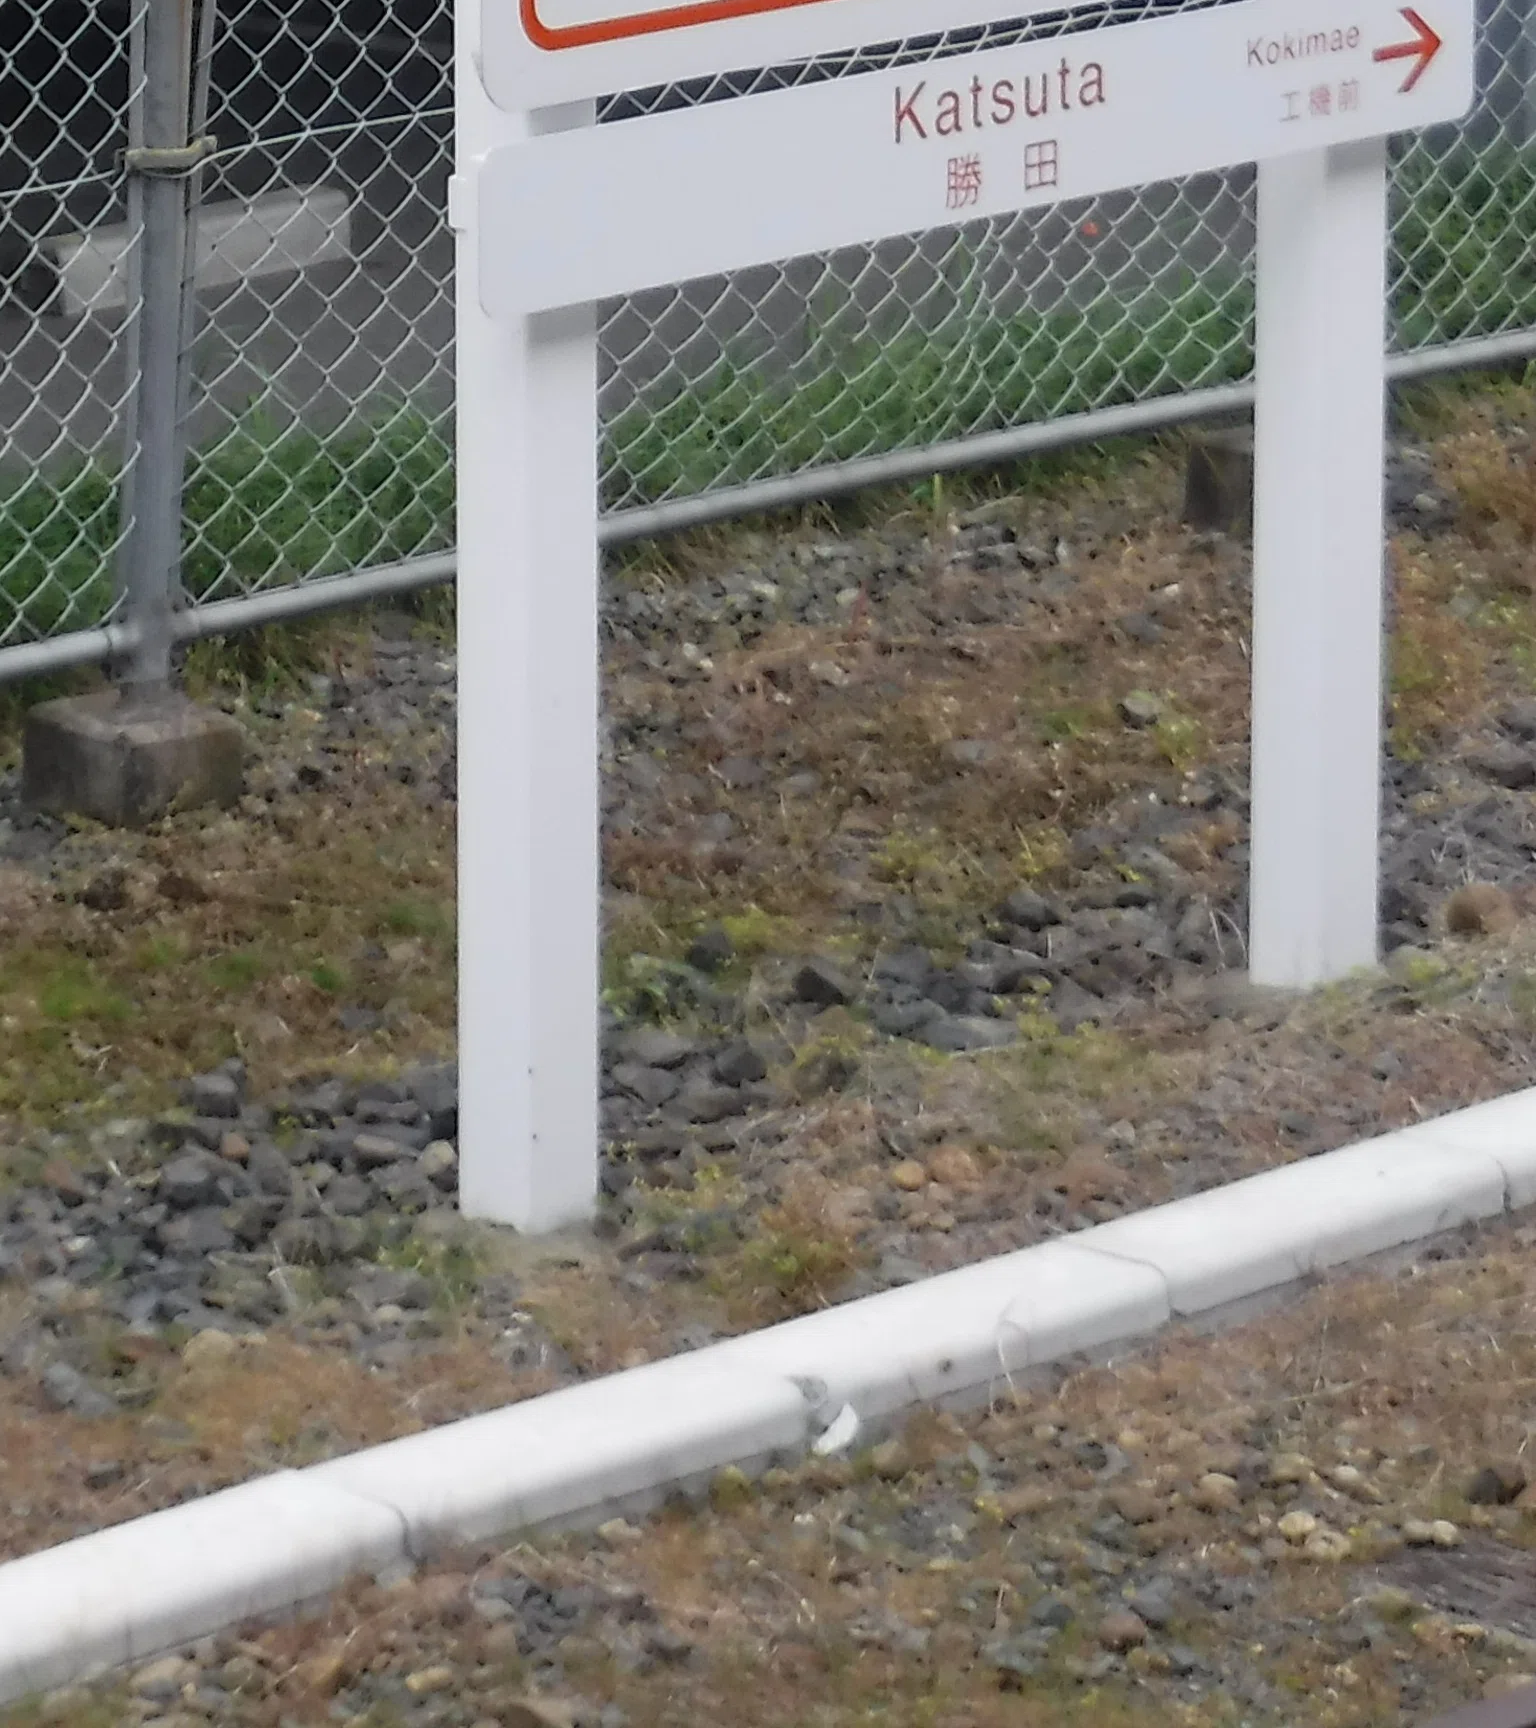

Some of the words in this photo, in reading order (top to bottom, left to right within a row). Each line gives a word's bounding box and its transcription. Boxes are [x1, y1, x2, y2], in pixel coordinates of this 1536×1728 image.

[1246, 23, 1362, 68] Kokimae
[893, 58, 1107, 145] Katsuta
[946, 139, 1059, 210] 勝田
